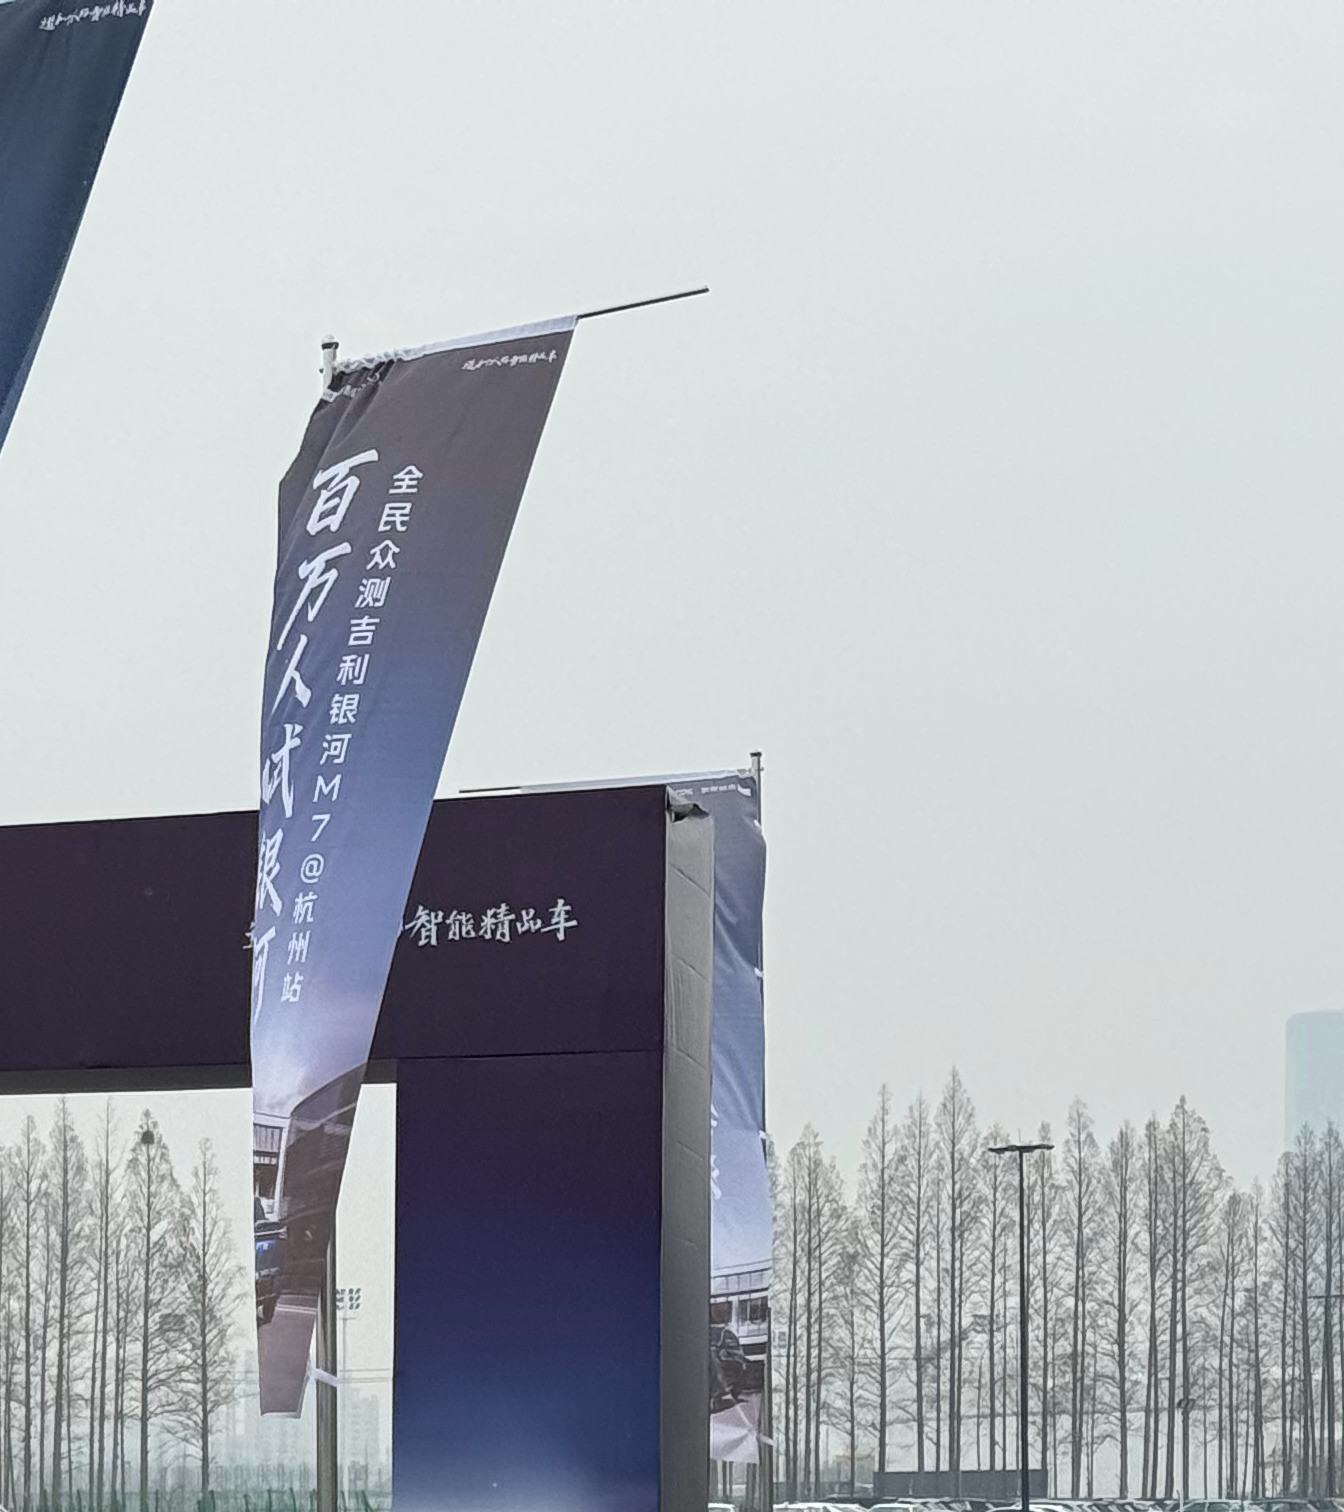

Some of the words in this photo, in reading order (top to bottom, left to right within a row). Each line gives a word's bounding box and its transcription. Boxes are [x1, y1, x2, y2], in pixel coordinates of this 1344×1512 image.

[280, 465, 424, 1003] 全民众测吉利银河M7@杭州站
